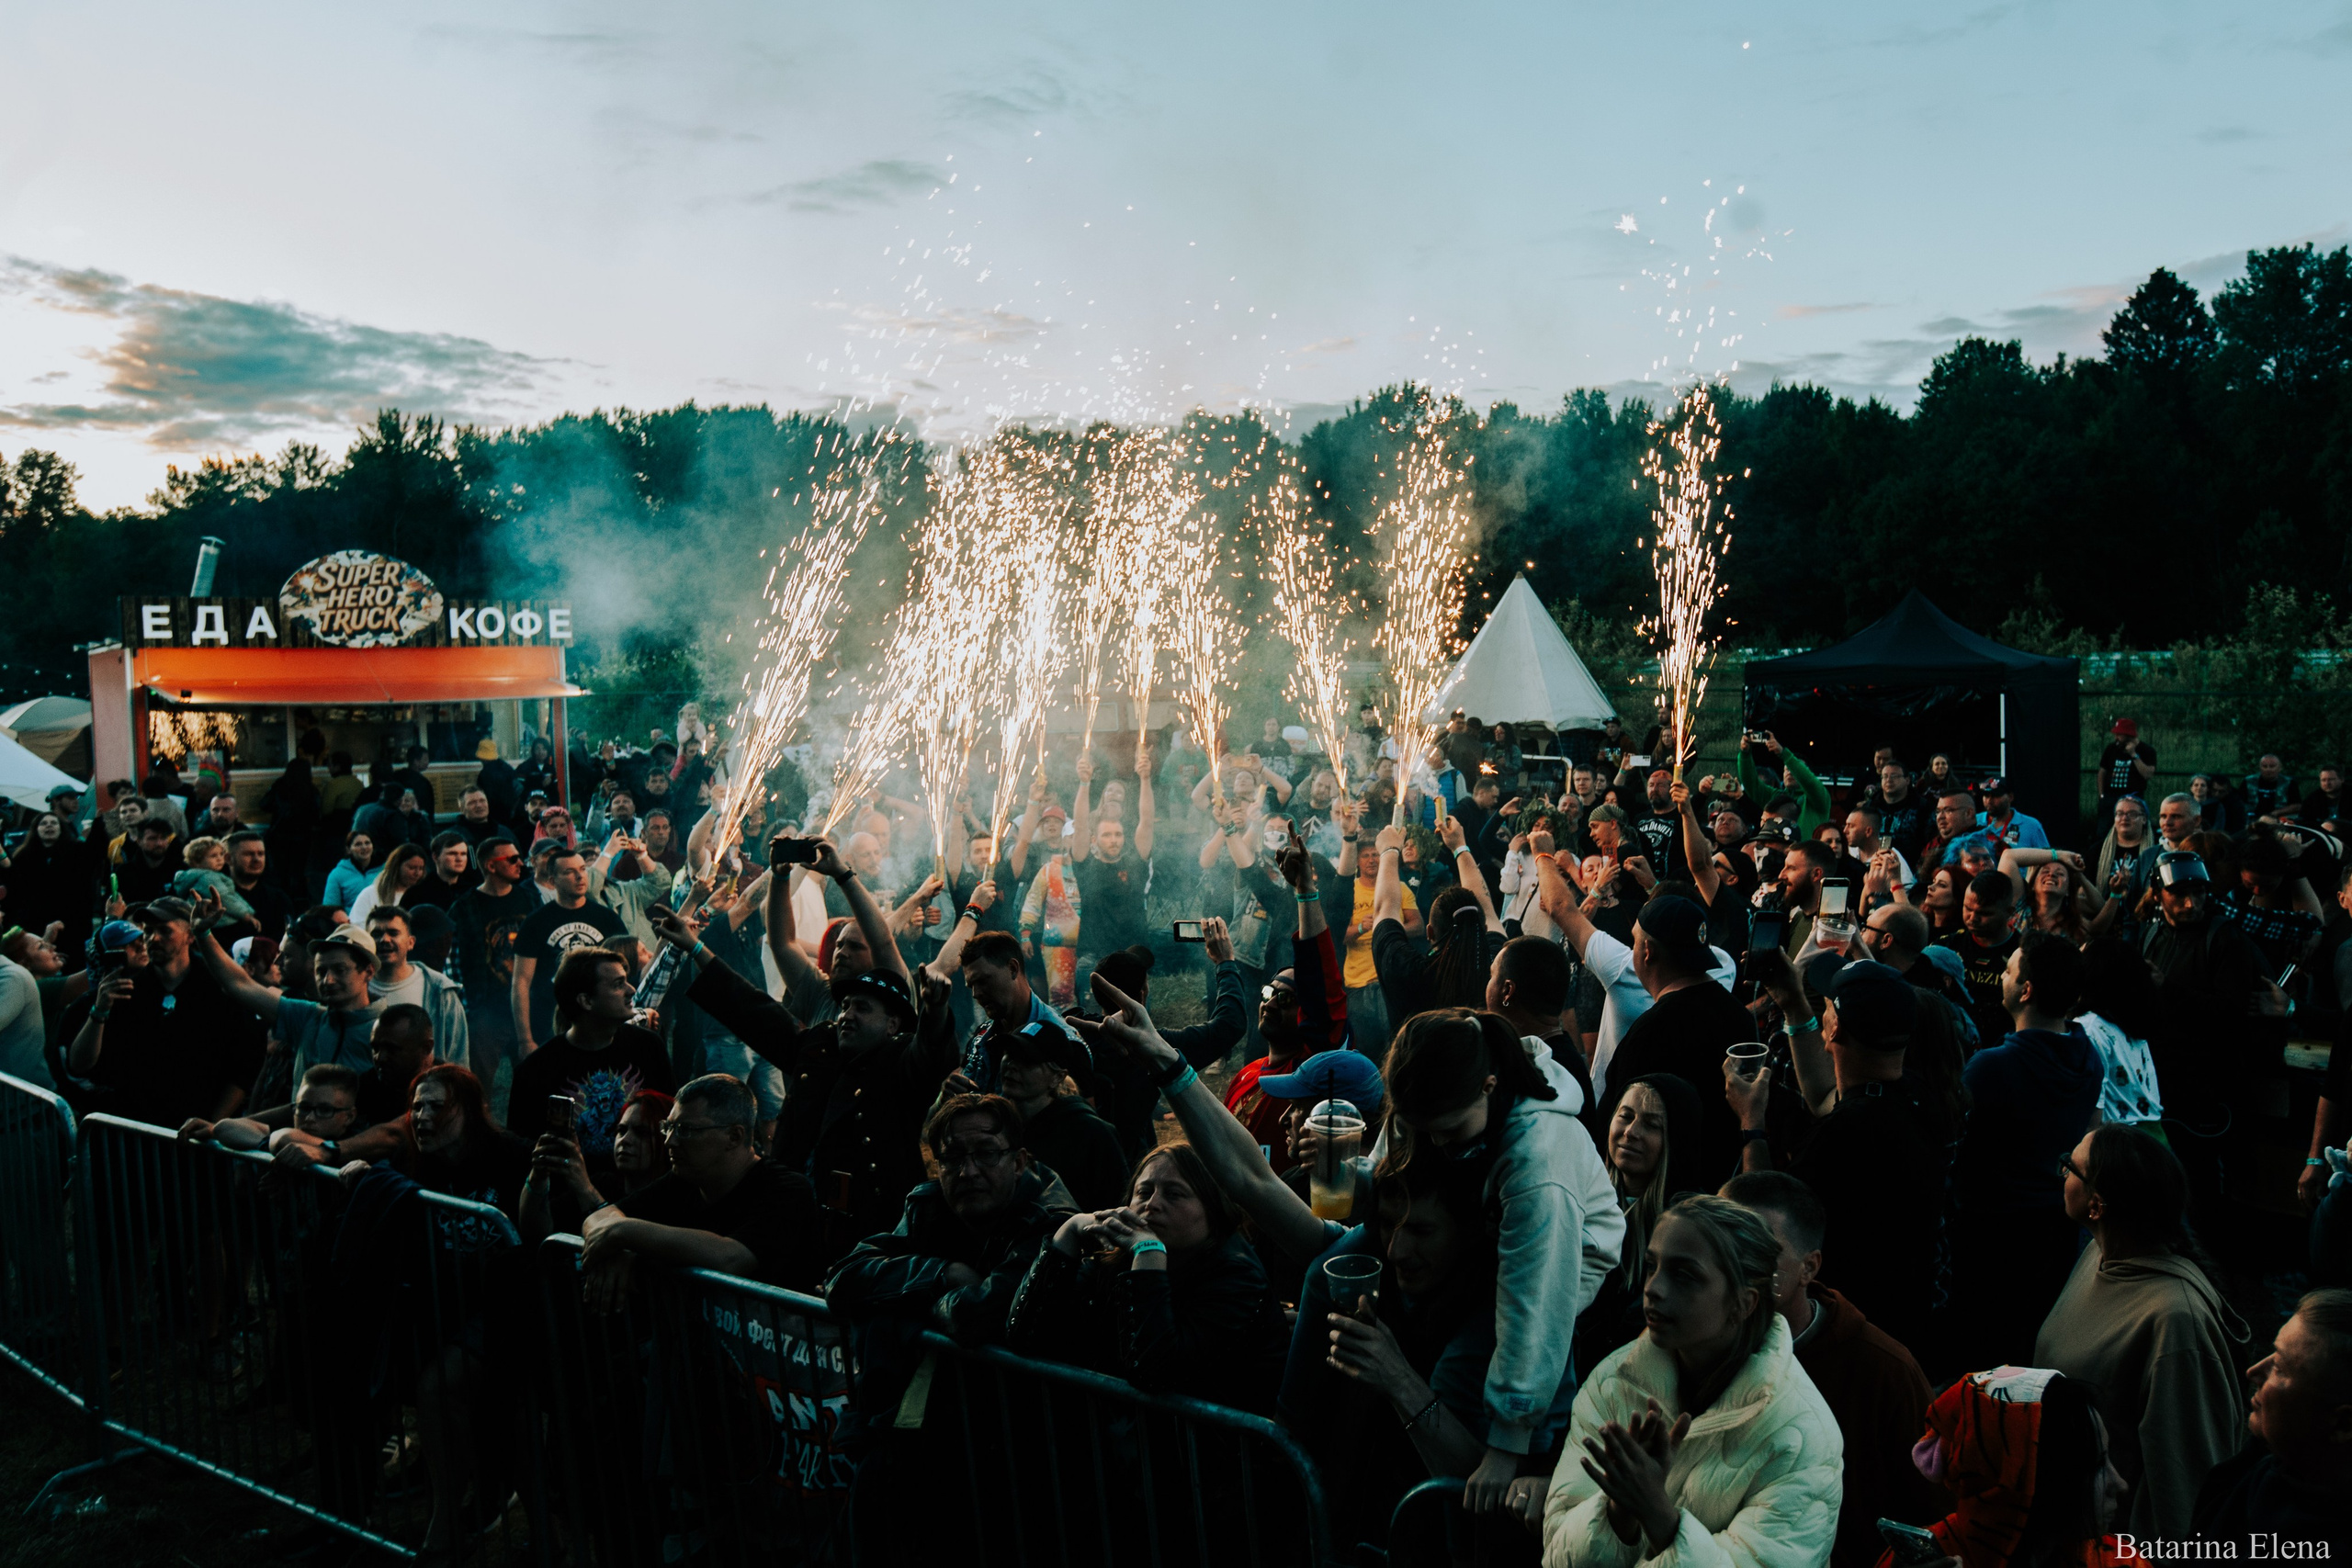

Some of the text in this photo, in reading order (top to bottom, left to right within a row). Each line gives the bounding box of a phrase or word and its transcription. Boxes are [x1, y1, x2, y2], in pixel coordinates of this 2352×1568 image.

[313, 561, 401, 593] SUPER
[327, 585, 394, 608] HERO
[142, 604, 277, 646] ЕДА
[320, 605, 403, 635] TRUCK
[449, 607, 572, 638] КОФЕ
